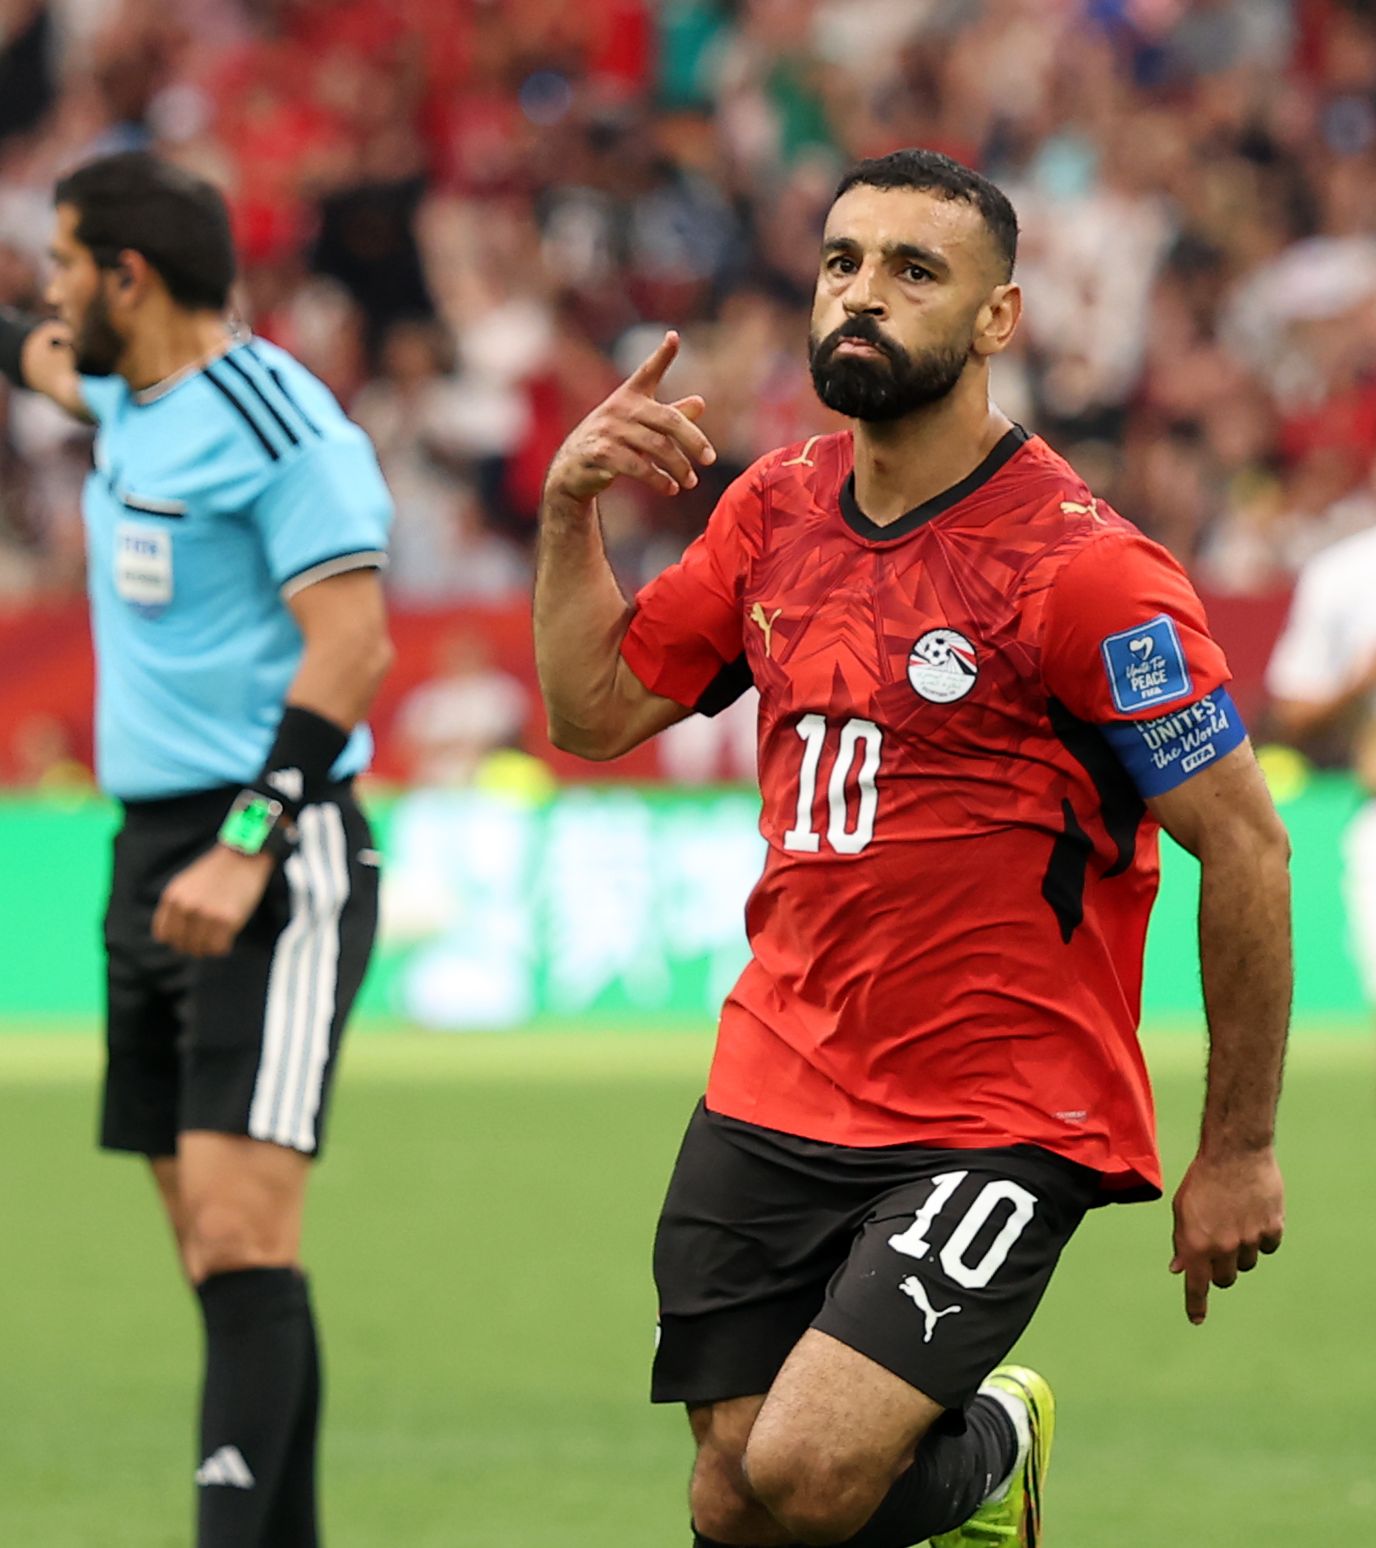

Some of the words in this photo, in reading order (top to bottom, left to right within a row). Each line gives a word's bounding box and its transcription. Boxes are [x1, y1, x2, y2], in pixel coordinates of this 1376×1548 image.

[1131, 669, 1168, 692] PEACE
[1143, 695, 1216, 750] UNITES
[1151, 748, 1181, 769] the
[1180, 709, 1229, 752] World
[783, 713, 883, 854] 10
[1183, 744, 1214, 770] FIFA
[888, 1170, 1039, 1288] 10
